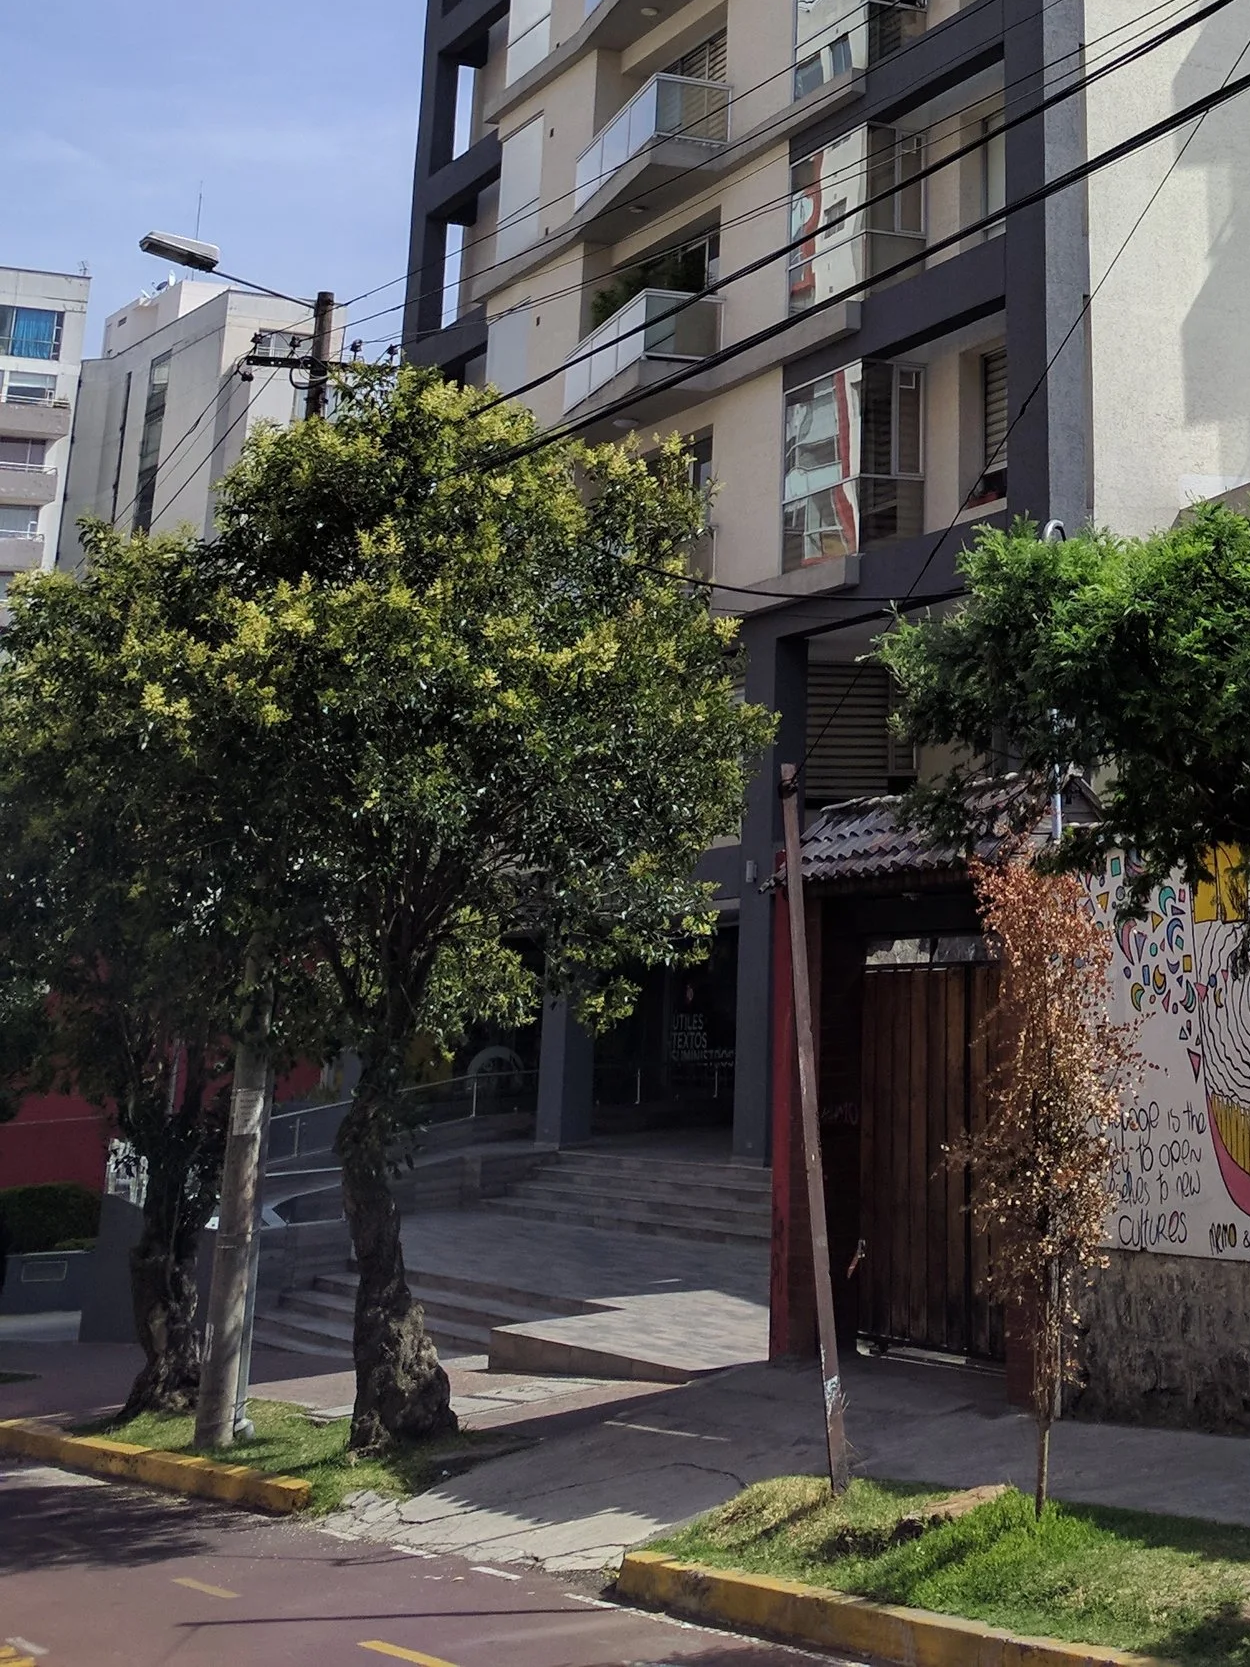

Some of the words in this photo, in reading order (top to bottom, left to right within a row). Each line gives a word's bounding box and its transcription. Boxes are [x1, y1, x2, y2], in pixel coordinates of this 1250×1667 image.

[672, 1031, 708, 1049] TEXTOS
[1167, 1108, 1181, 1133] is
[1183, 1100, 1206, 1134] the
[1135, 1136, 1154, 1174] to
[1159, 1139, 1201, 1171] open
[1156, 1170, 1169, 1204] to
[1176, 1170, 1201, 1200] new
